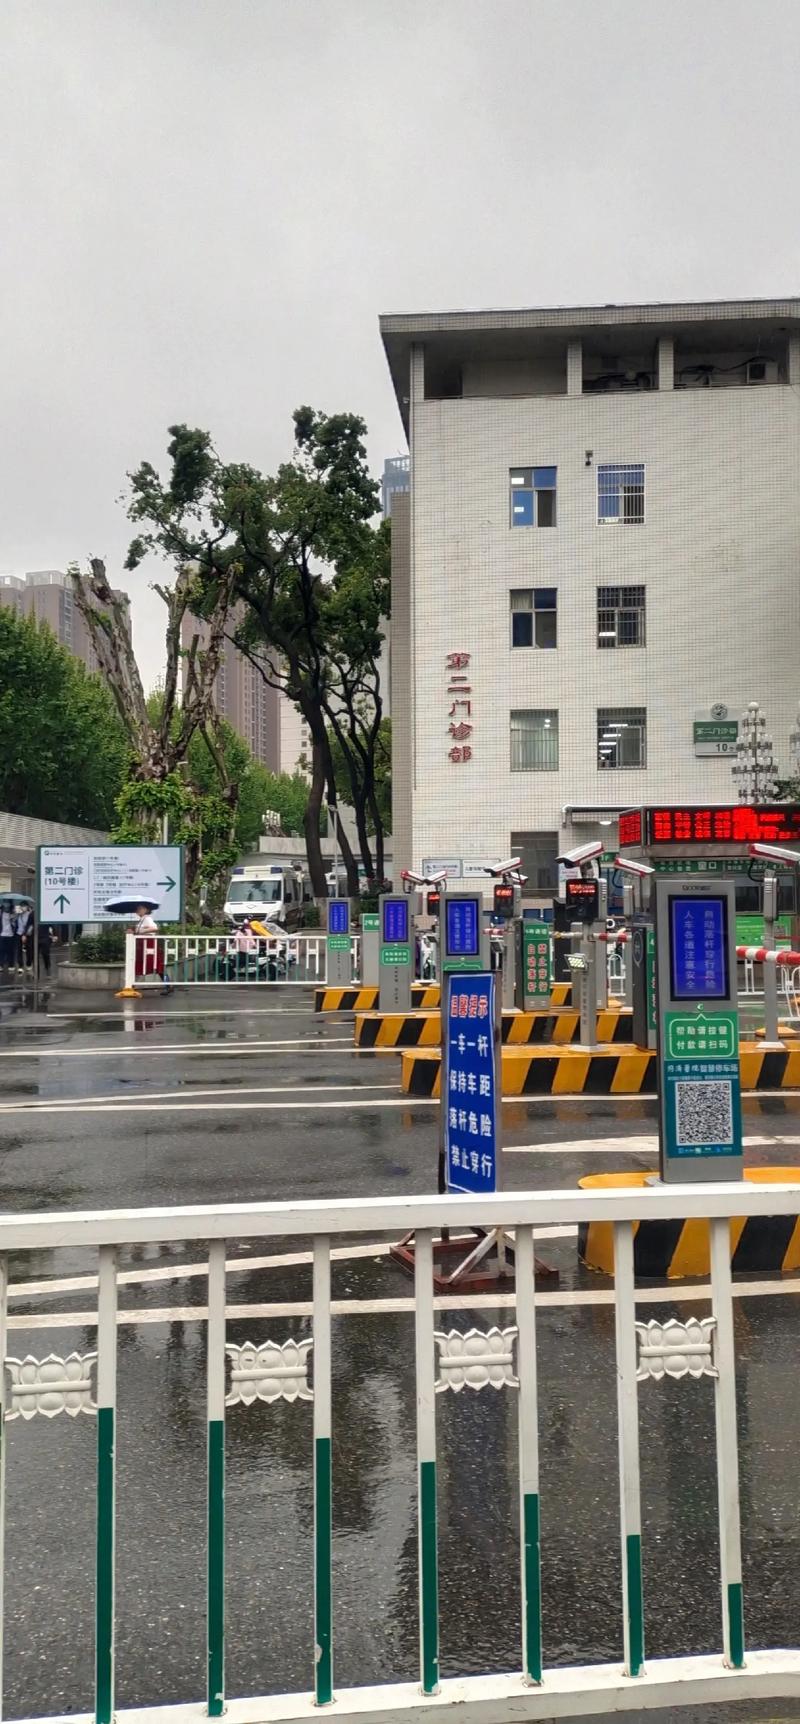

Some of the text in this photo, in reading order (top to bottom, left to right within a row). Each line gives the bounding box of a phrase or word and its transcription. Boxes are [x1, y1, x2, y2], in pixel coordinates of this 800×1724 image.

[446, 653, 472, 763] 第二门诊部
[44, 866, 84, 875] 第二门诊
[450, 1032, 489, 1057] 一车一杆
[449, 1069, 491, 1097] 保持车距
[449, 1107, 492, 1138] 落杆危险
[451, 1144, 493, 1178] 禁止穿行
